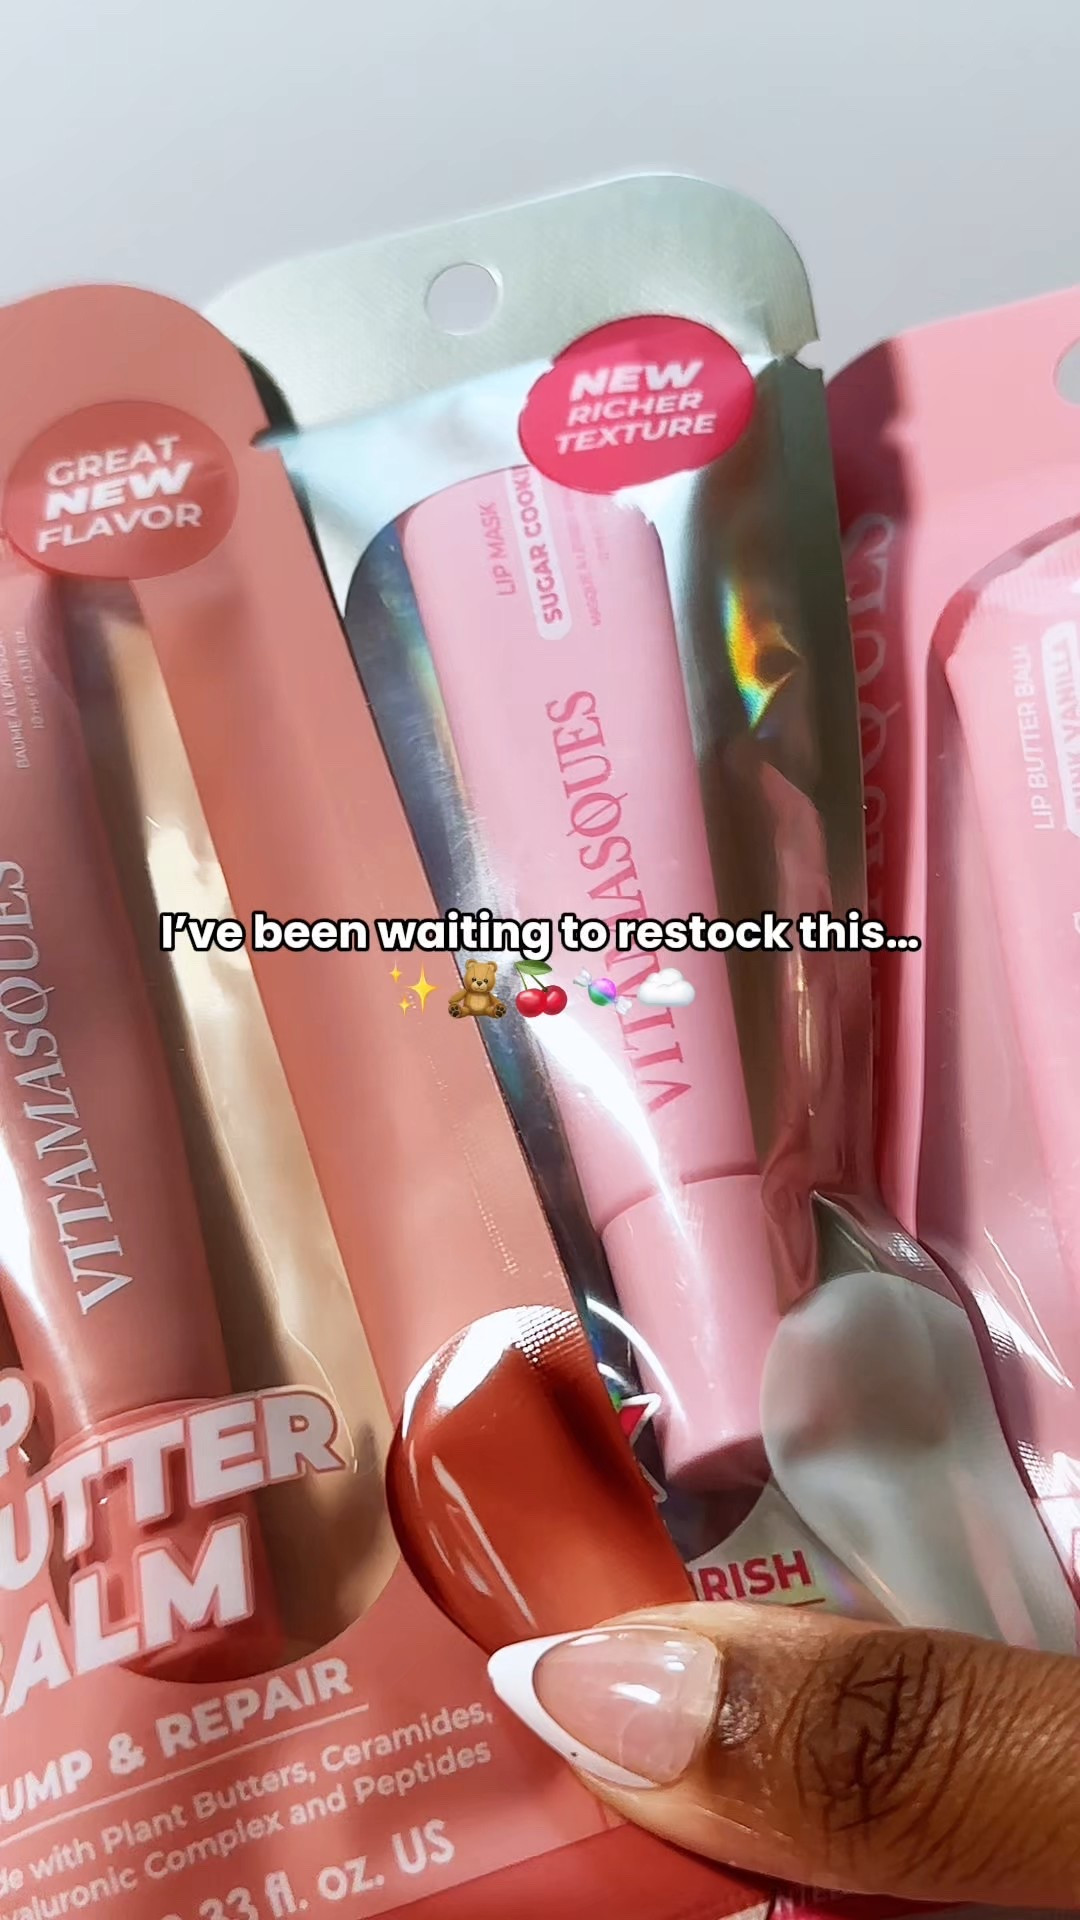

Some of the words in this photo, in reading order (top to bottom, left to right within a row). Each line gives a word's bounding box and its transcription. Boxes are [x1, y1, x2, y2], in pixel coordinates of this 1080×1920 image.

[567, 391, 704, 427] RICHER
[569, 360, 704, 402] NEW
[47, 435, 180, 487] GREAT
[555, 413, 717, 455] TEXTURE
[45, 461, 194, 521] NEW
[512, 468, 542, 539] COOKI
[37, 503, 202, 553] FLAVOR
[478, 501, 507, 561] MASK
[492, 564, 517, 596] LIP
[529, 543, 563, 624] SUGAR
[1017, 703, 1049, 789] BUTTER
[1031, 795, 1055, 830] LIP
[0, 861, 133, 1316] VITAMASQUES
[0, 1392, 347, 1592] UTTER
[690, 1551, 812, 1601] RISH
[0, 1522, 250, 1718] ALM
[0, 1748, 93, 1823] UMP
[108, 1733, 146, 1775] &
[155, 1657, 353, 1758] REPAIR
[0, 1867, 24, 1899] de
[29, 1838, 96, 1880] with
[101, 1804, 187, 1855] Plant
[192, 1761, 316, 1820] Butters,
[321, 1702, 494, 1773] Ceramides,
[0, 1865, 138, 1920] yaluronic
[144, 1809, 285, 1880] Complex
[290, 1783, 347, 1825] and
[353, 1741, 491, 1805] Peptides
[265, 1870, 309, 1918] fl.
[318, 1855, 385, 1901] oz.
[391, 1818, 455, 1874] US
